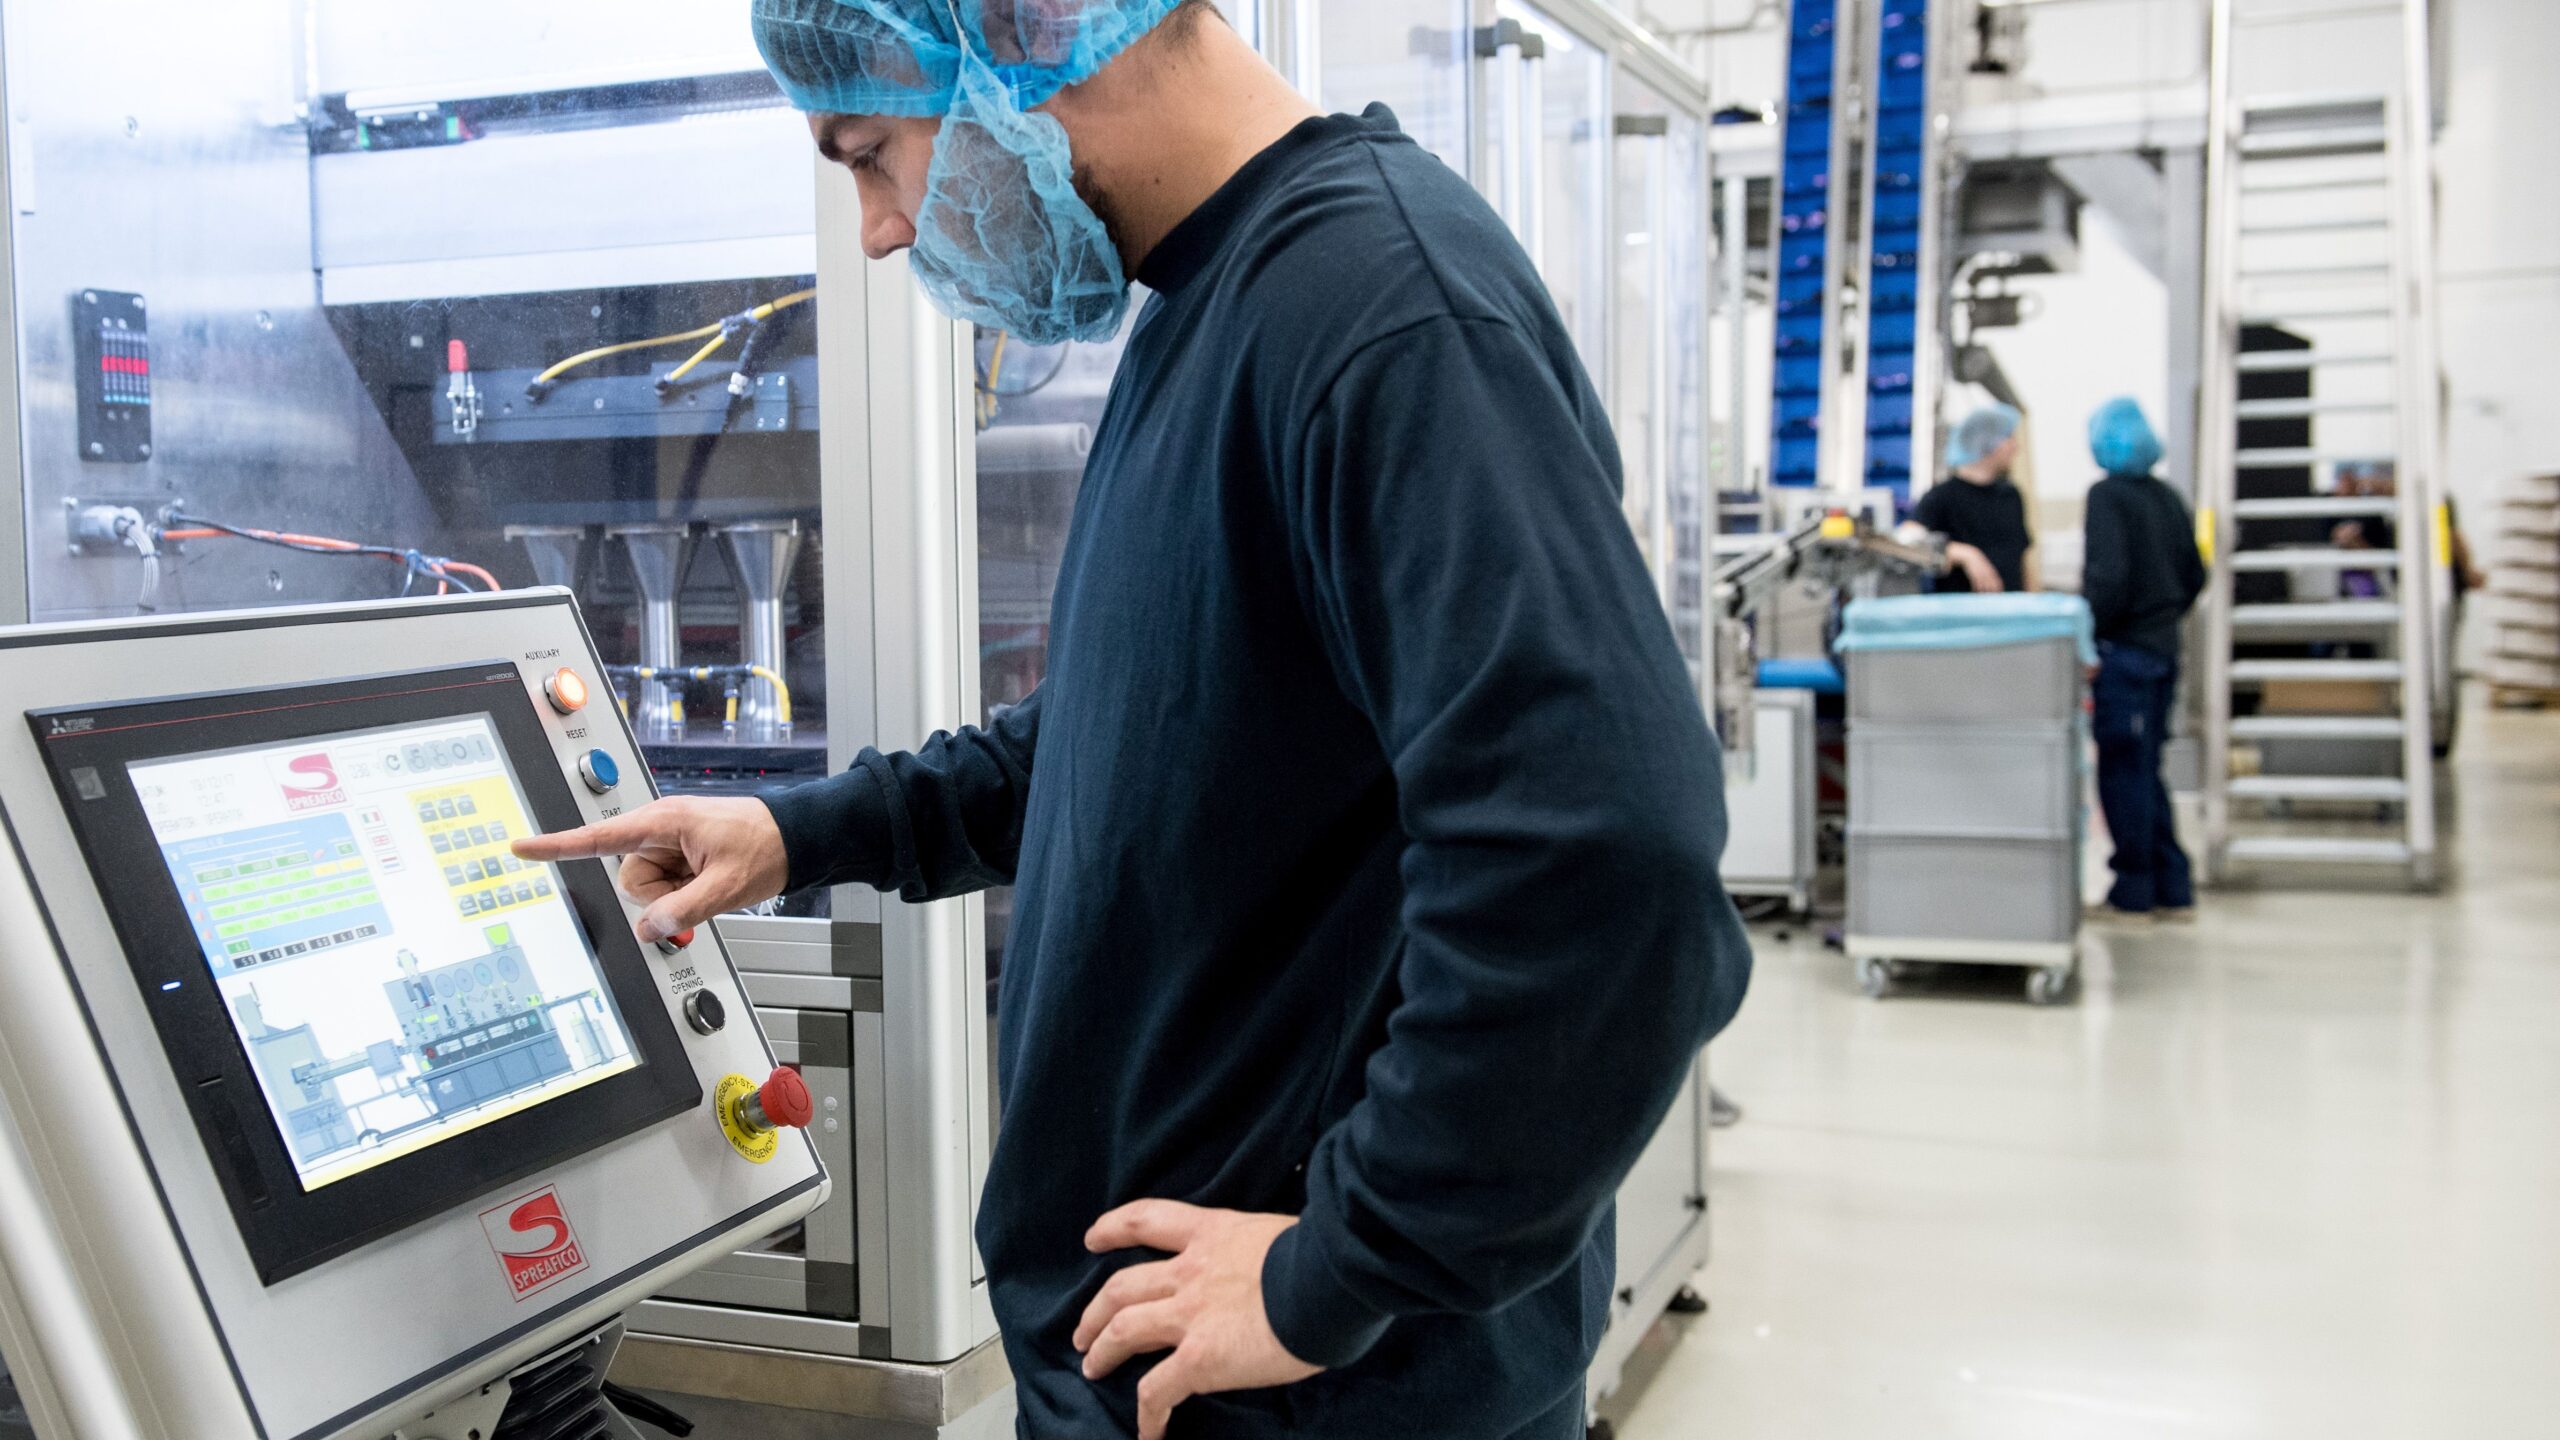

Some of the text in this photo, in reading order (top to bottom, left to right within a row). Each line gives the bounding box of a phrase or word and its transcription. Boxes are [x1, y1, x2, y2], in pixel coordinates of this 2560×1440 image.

[525, 648, 561, 661] AUXILIARY
[565, 728, 588, 740] RESET
[288, 789, 346, 810] SPREAFICO
[601, 807, 622, 820] START
[669, 966, 697, 983] DOORS
[671, 977, 704, 995] OPENING
[717, 1076, 756, 1127] EMERGENCY-STO
[732, 1129, 776, 1159] EMERGENCY-S
[514, 1248, 579, 1291] SPREAFICO
